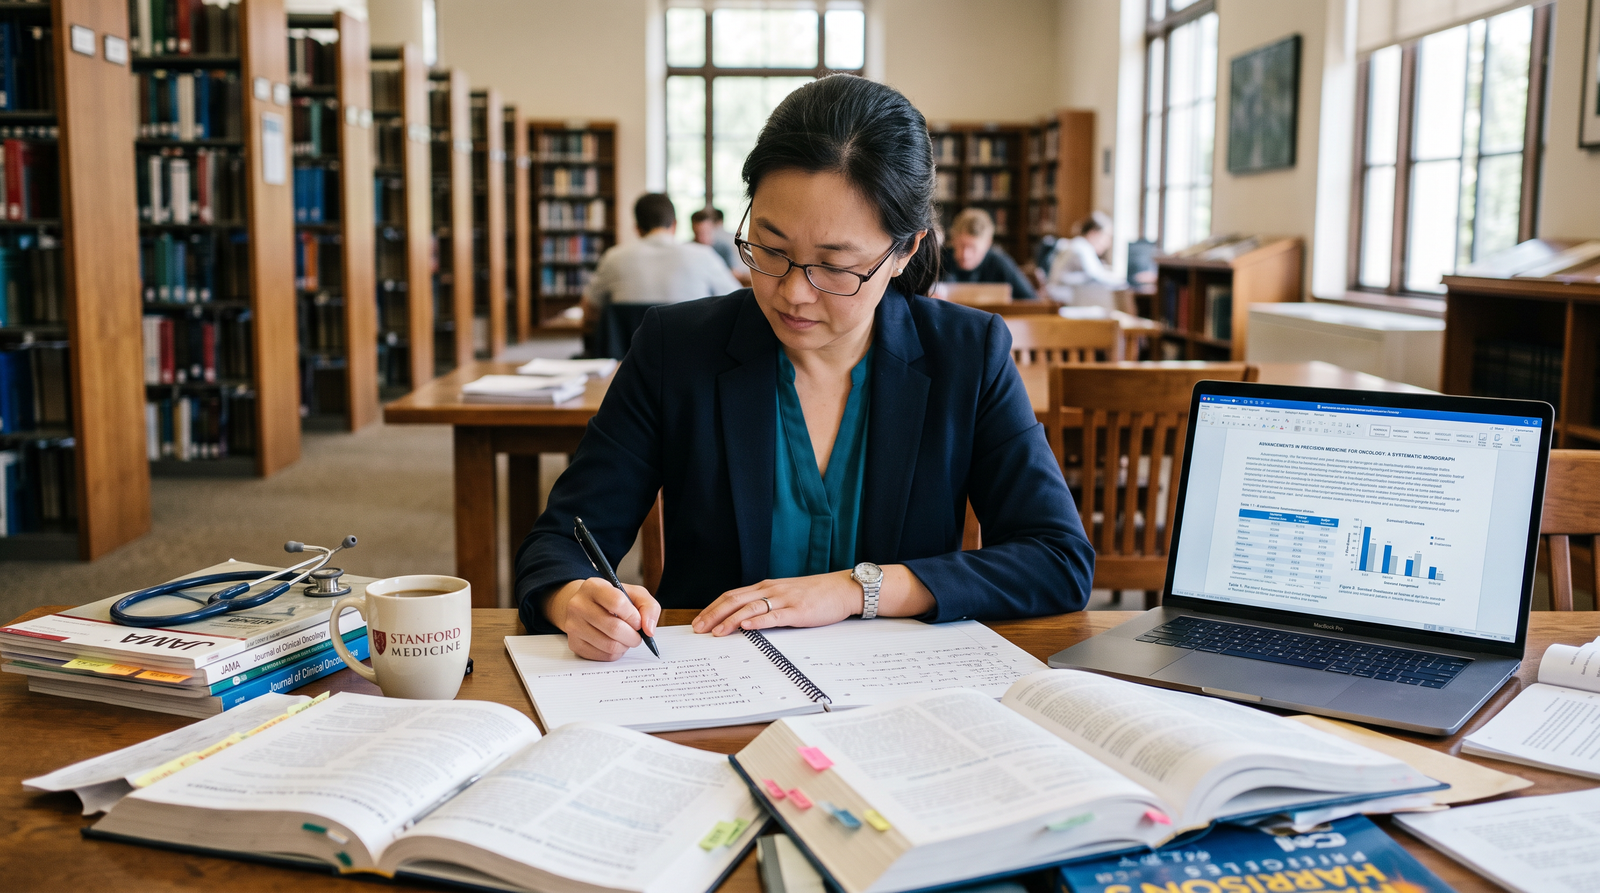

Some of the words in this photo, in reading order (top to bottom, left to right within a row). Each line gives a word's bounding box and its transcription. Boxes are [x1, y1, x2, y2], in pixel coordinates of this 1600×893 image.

[1423, 454, 1456, 462] MONOGRAPH
[1313, 622, 1335, 631] MacBook
[119, 632, 216, 651] JAMA
[390, 627, 461, 645] STANFORD
[391, 640, 461, 657] MEDICINE
[220, 660, 241, 675] JAMA
[253, 647, 275, 662] Journal
[275, 645, 282, 654] of
[269, 674, 293, 693] Journal
[294, 672, 301, 682] of
